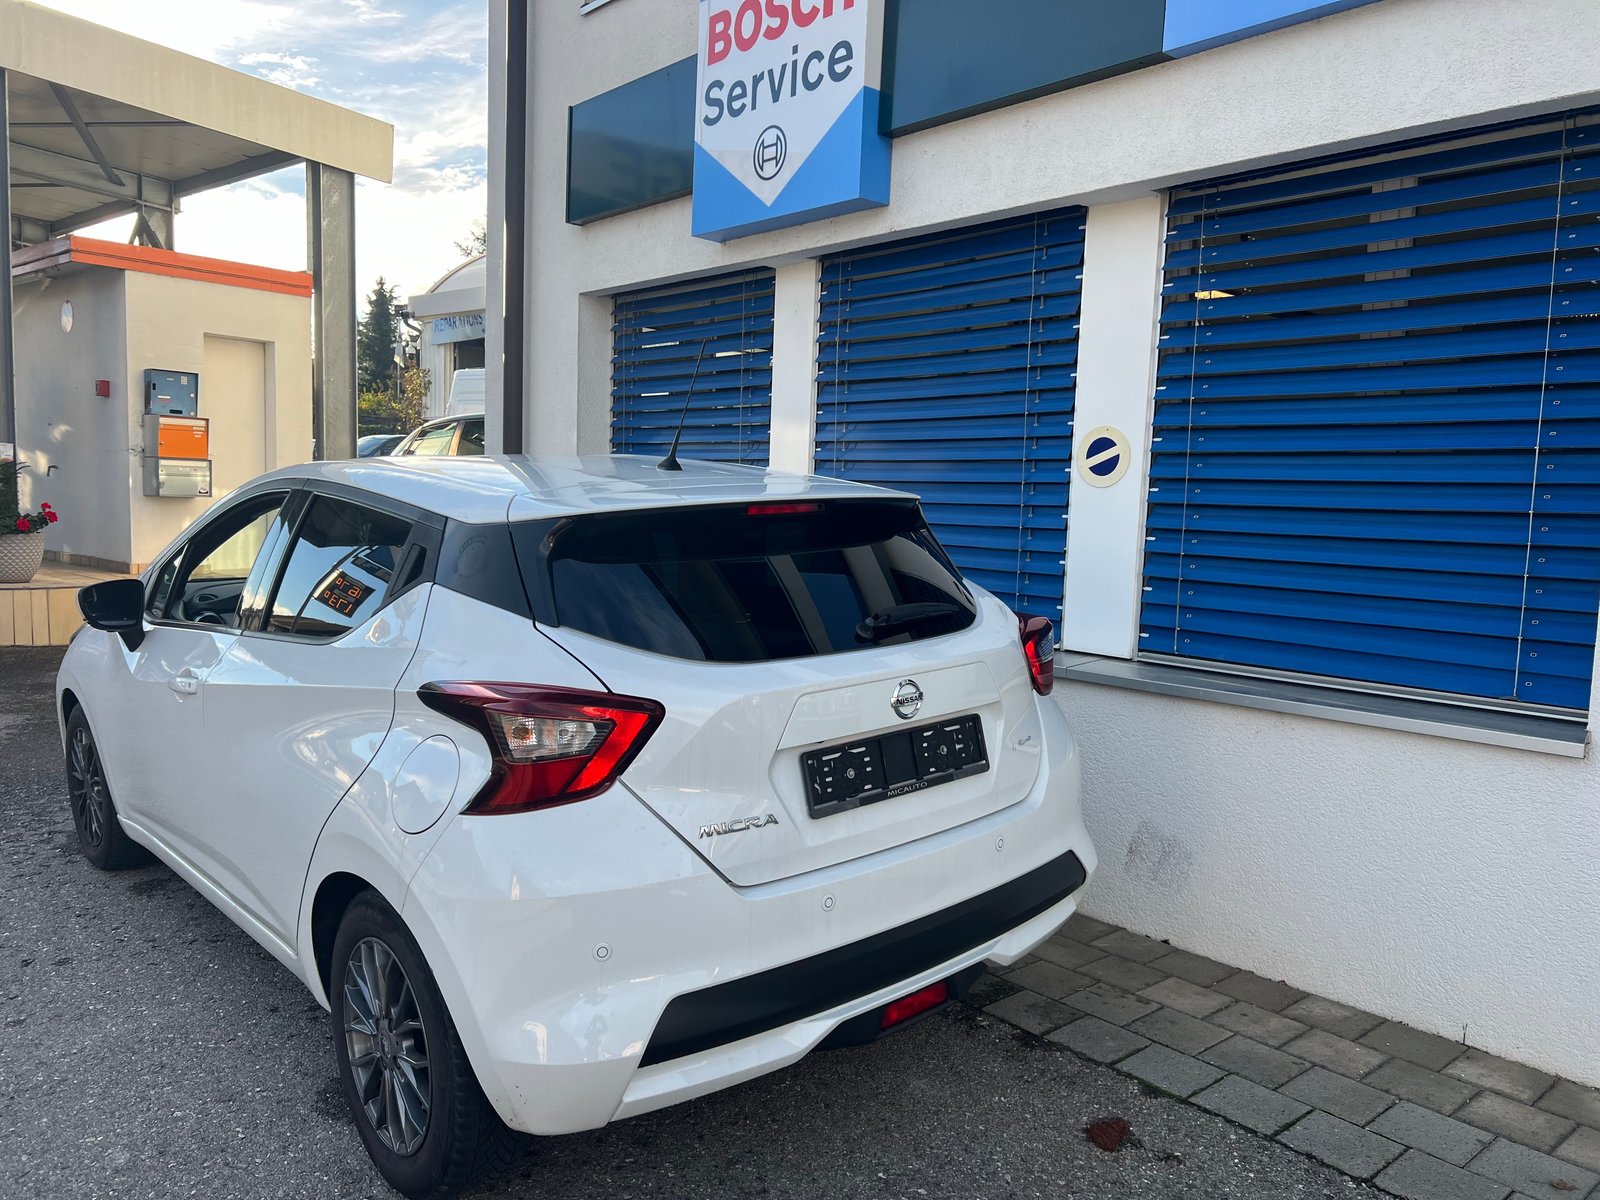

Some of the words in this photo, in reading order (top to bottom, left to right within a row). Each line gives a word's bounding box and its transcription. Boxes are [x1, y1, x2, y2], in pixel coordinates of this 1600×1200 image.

[702, 40, 854, 127] Service
[896, 691, 924, 706] NISSAN
[887, 781, 928, 797] MICAUTO
[698, 813, 779, 839] MICRA
